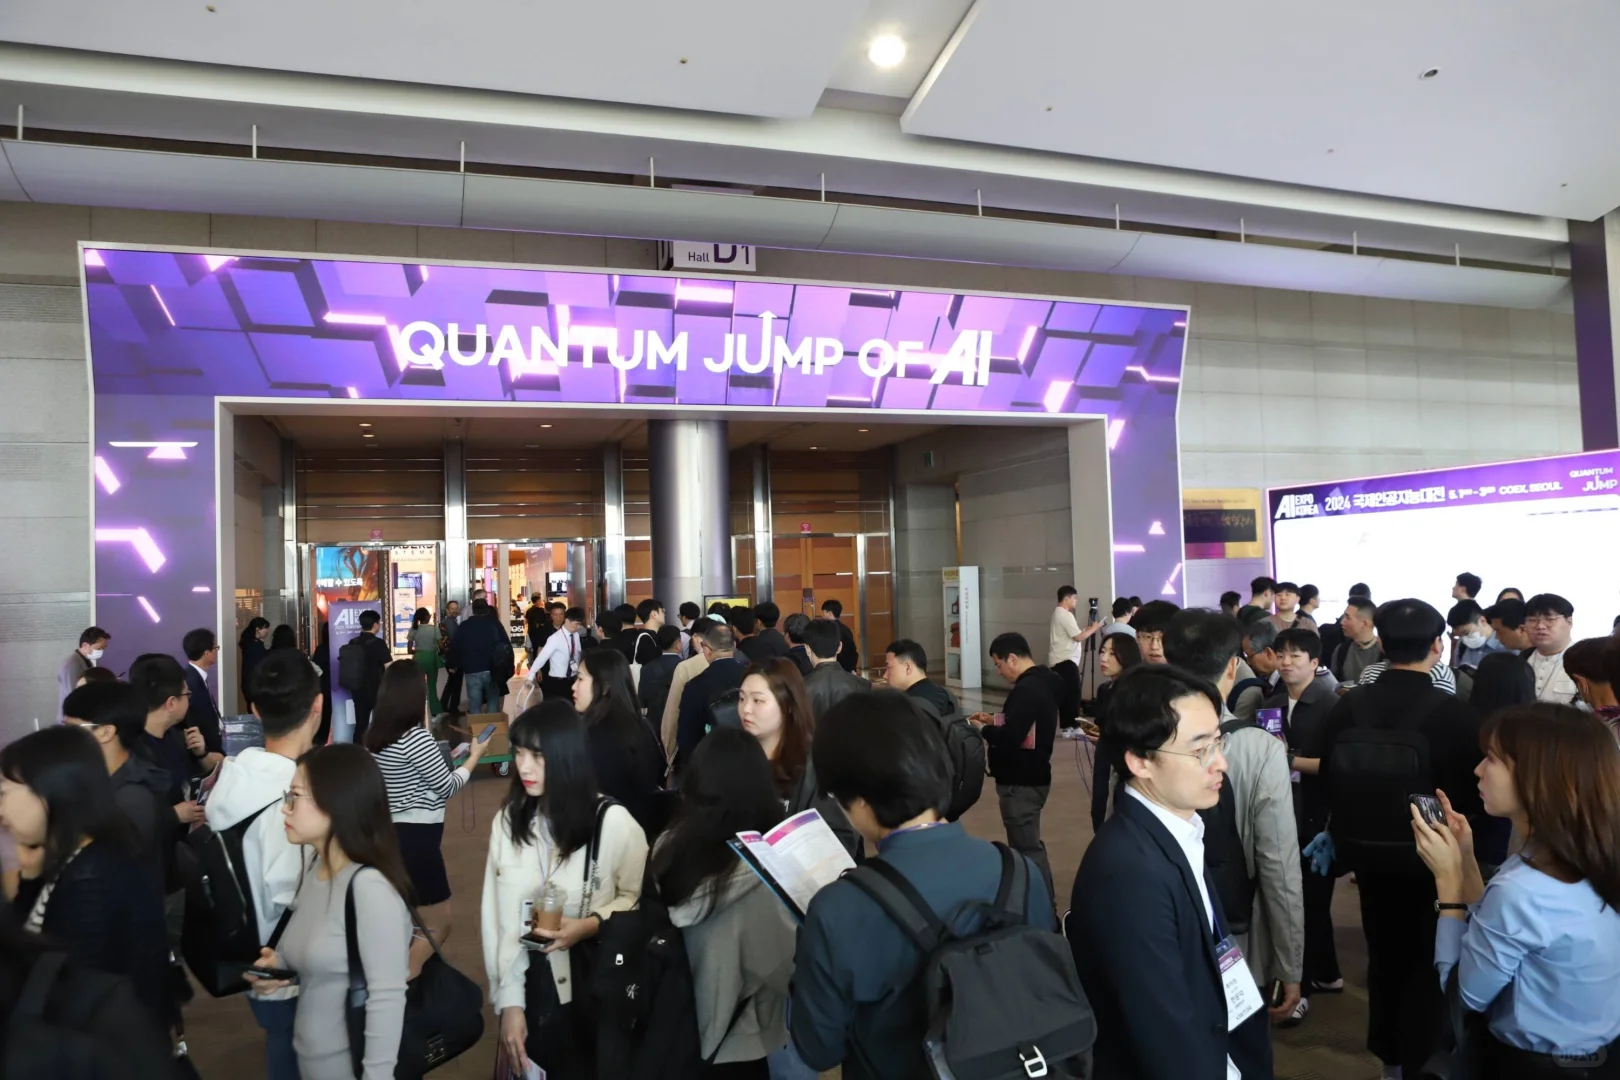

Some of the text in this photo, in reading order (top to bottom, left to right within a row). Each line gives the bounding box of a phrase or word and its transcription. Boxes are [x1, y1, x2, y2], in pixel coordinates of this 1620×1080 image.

[688, 243, 749, 265] Hall D1
[399, 311, 993, 386] QUANTUM JUMP OF AI
[1569, 467, 1614, 478] QUANTUM
[1582, 475, 1619, 492] JUMP
[1274, 493, 1314, 519] AI EXPO
[1325, 495, 1352, 512] 2024
[1529, 481, 1563, 493] SEOUL
[1296, 504, 1320, 517] KOREA
[333, 608, 355, 626] AI
[354, 608, 371, 617] EX
